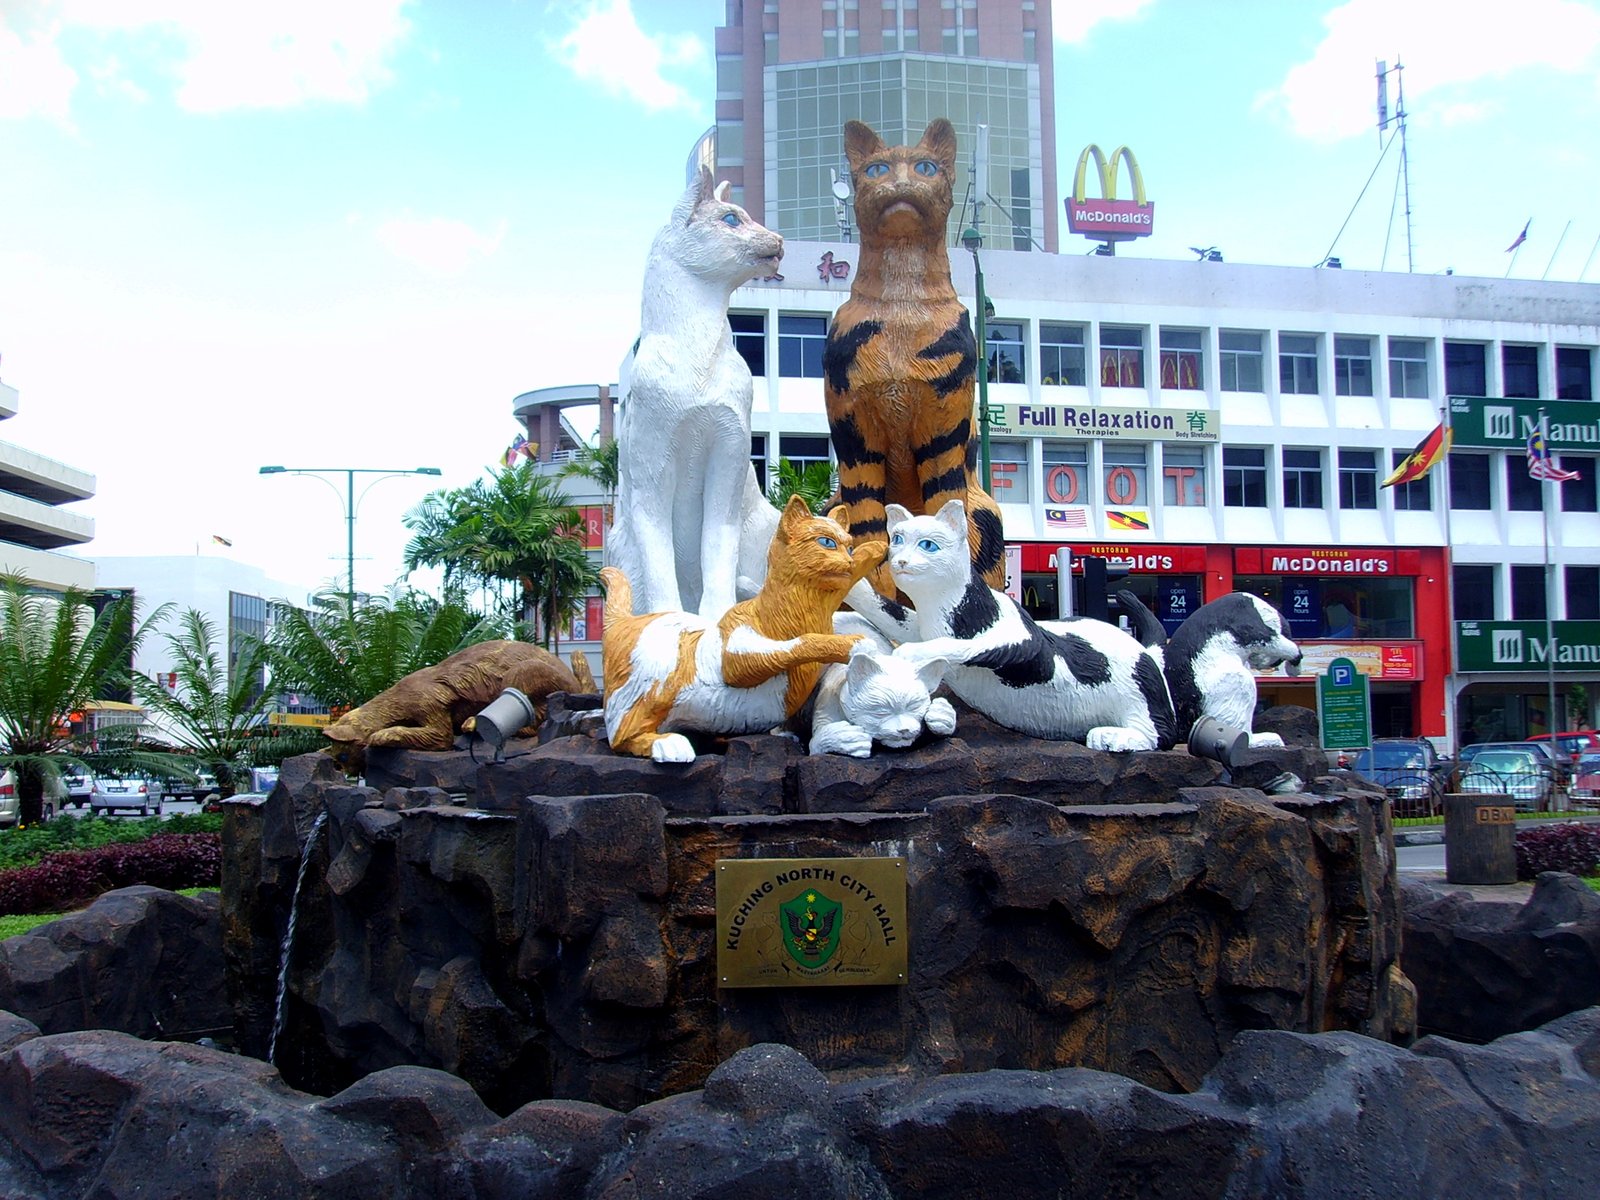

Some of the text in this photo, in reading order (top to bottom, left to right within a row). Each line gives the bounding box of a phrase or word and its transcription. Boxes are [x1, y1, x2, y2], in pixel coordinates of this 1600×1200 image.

[1075, 210, 1151, 225] McDonald's
[1018, 405, 1174, 430] Full Relaxation
[1186, 410, 1207, 432] 脊
[1076, 428, 1120, 437] Therapies
[1175, 431, 1217, 440] Body Stretching
[1272, 557, 1389, 572] McDonald's
[1170, 595, 1187, 607] 24
[1293, 596, 1310, 608] 24
[1335, 668, 1349, 683] P
[726, 867, 896, 951] KUCHING NORTH CITY HALL
